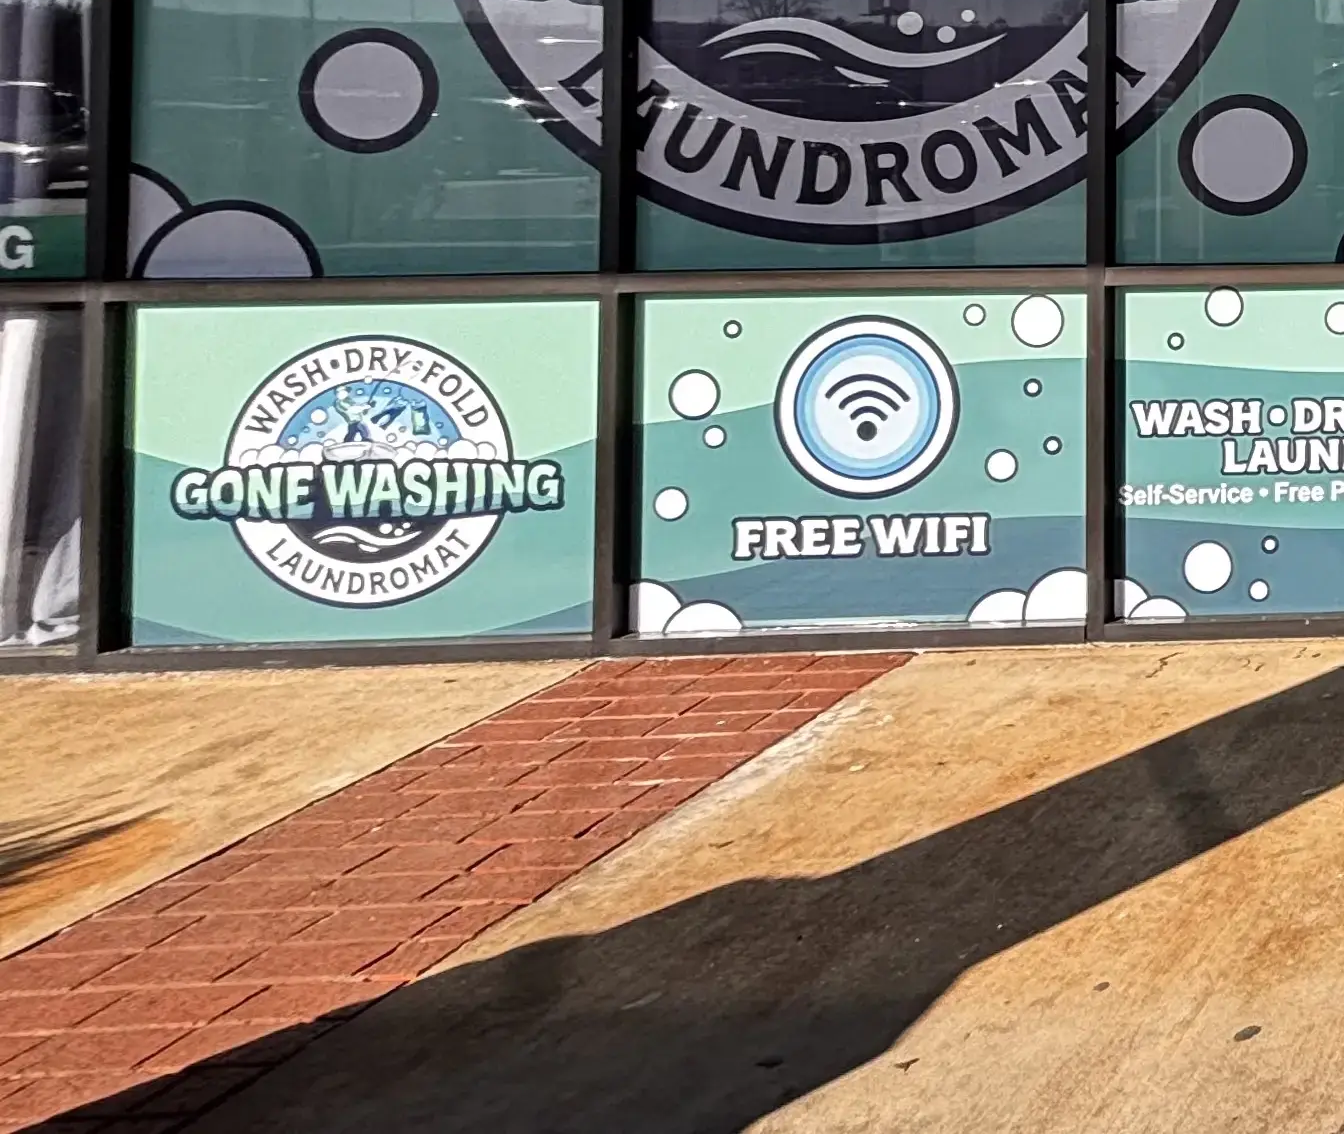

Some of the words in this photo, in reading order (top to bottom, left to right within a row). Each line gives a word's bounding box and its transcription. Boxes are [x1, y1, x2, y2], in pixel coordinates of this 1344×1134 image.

[245, 352, 329, 436] WASH
[345, 348, 410, 373] DRY
[423, 363, 489, 430] FOLD
[1132, 399, 1262, 437] WASH
[175, 467, 313, 519] GONE
[321, 460, 563, 519] WASHING
[1119, 482, 1254, 507] Self-Service
[1274, 482, 1325, 505] Free
[265, 527, 471, 596] LAUNDROMAT
[733, 516, 864, 558] FREE
[871, 514, 991, 556] WIFI
